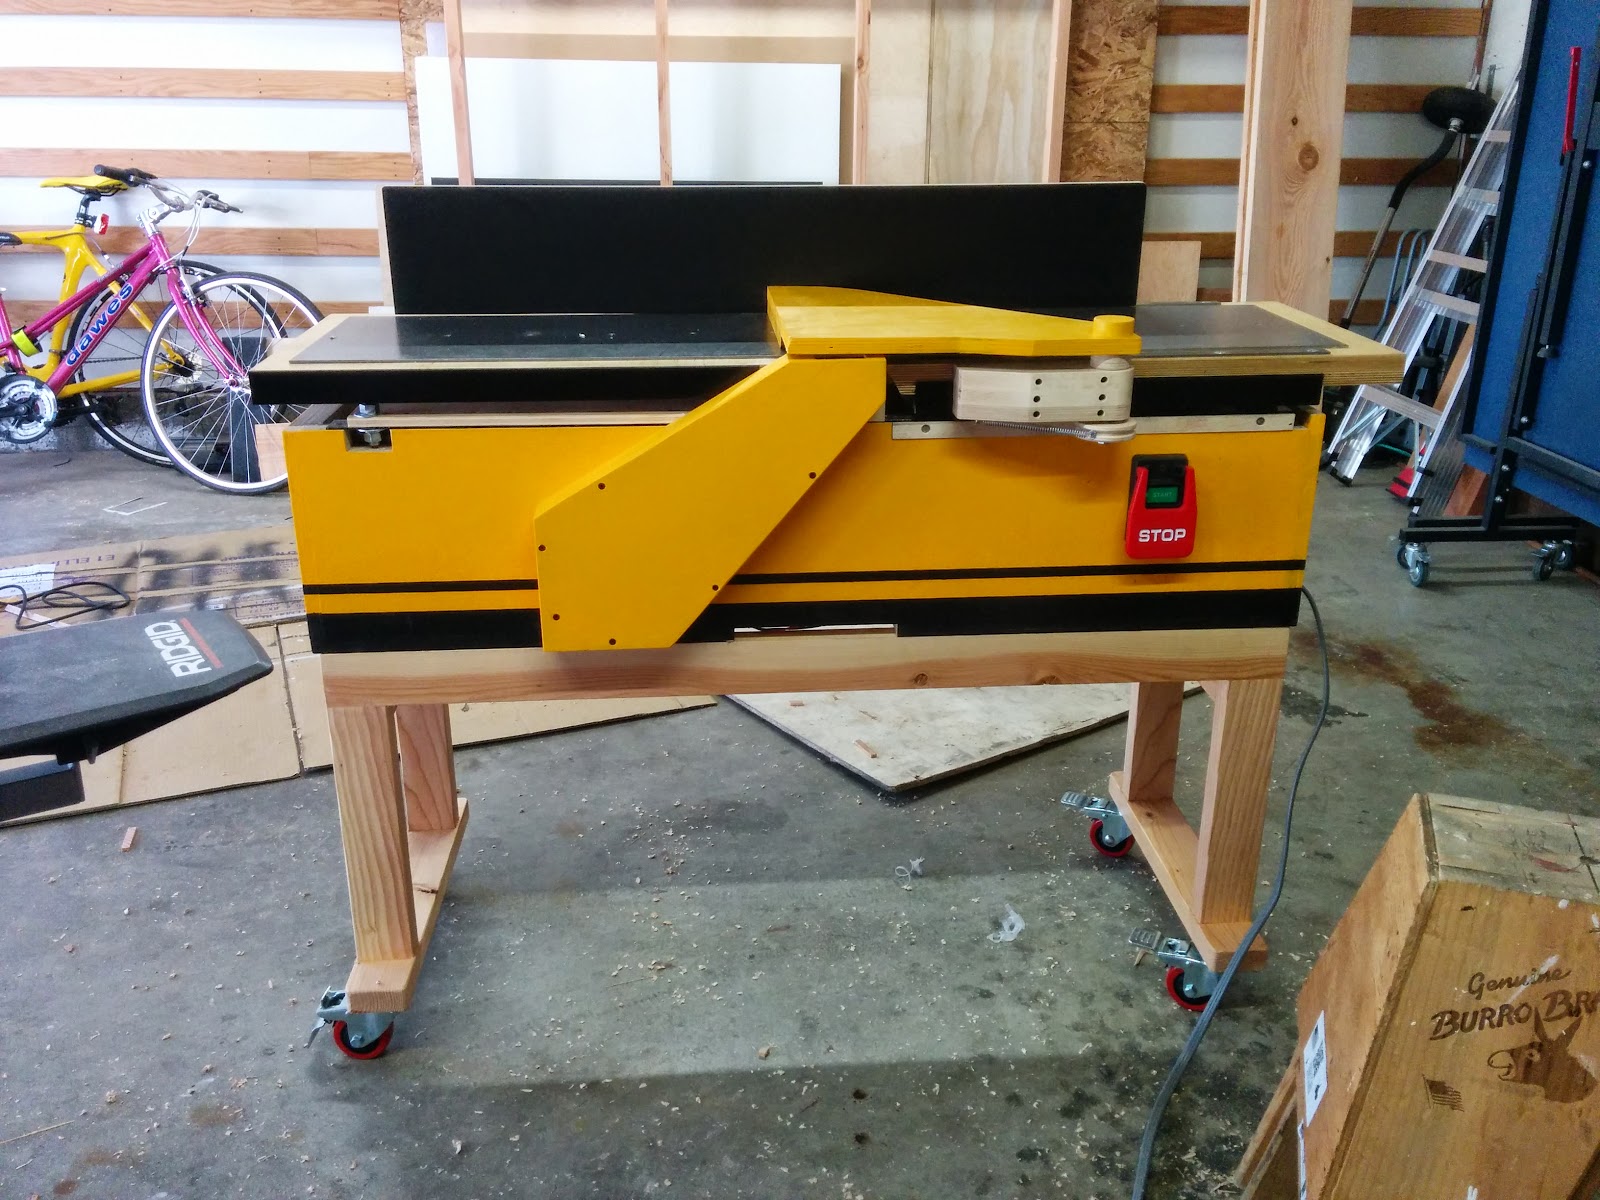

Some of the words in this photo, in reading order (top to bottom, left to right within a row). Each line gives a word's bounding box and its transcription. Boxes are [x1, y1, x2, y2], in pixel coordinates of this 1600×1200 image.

[66, 282, 134, 367] dawes
[1138, 528, 1187, 542] STOP
[144, 620, 212, 677] RIDGID
[1467, 967, 1572, 1000] Genuine
[1429, 1002, 1532, 1040] BURRO
